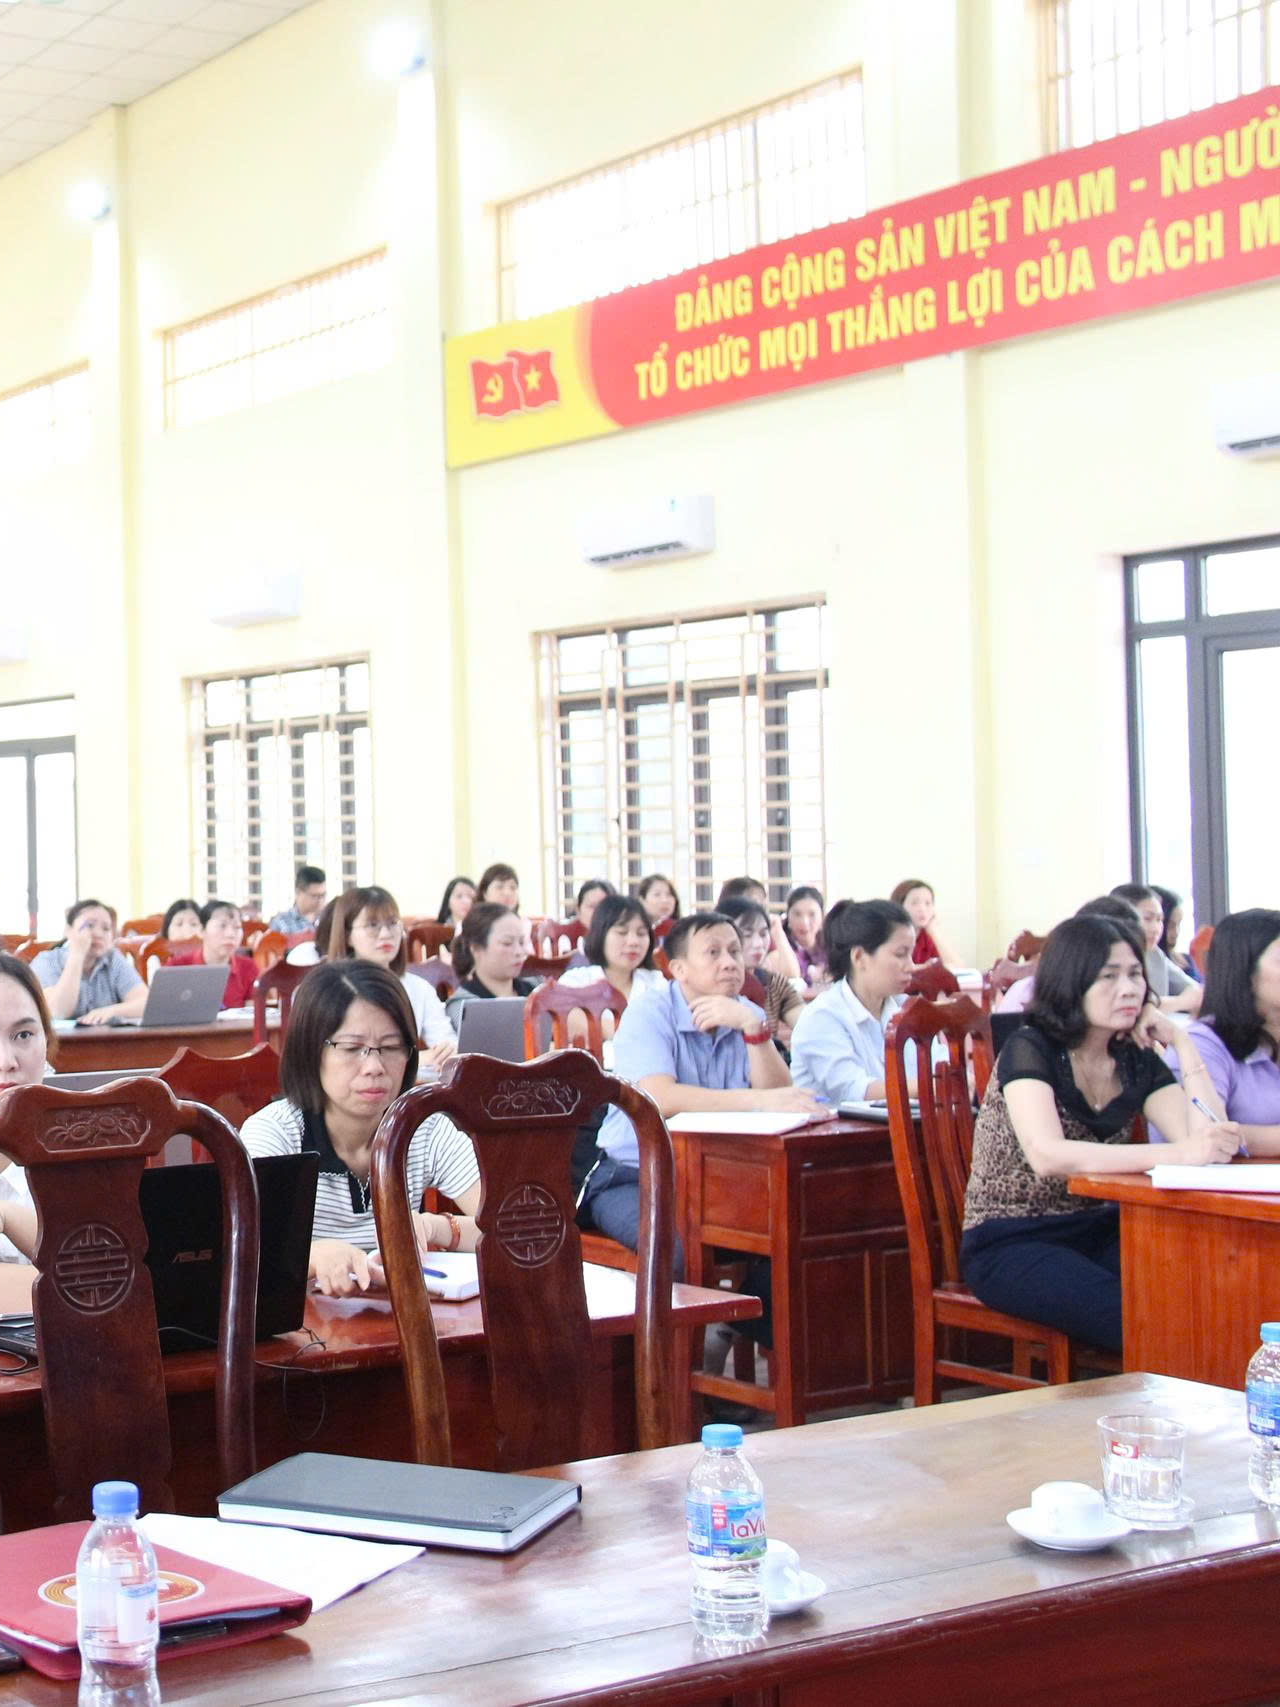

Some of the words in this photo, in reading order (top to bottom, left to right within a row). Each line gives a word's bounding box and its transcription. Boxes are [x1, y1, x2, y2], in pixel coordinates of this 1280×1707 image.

[634, 342, 668, 401] TỔ
[674, 332, 751, 391] CHỨC
[759, 317, 819, 373] MỌI
[826, 284, 937, 354] THẮNG
[946, 266, 1005, 329] LỢI
[1015, 237, 1096, 308] CỦA
[1107, 217, 1224, 285] CÁCH
[675, 273, 753, 332] ĐẢNG
[761, 247, 846, 311] CỘNG
[855, 217, 925, 282] SẢN
[934, 195, 1012, 260] VIỆT
[1022, 165, 1117, 236] NAM
[1129, 177, 1147, 192] -
